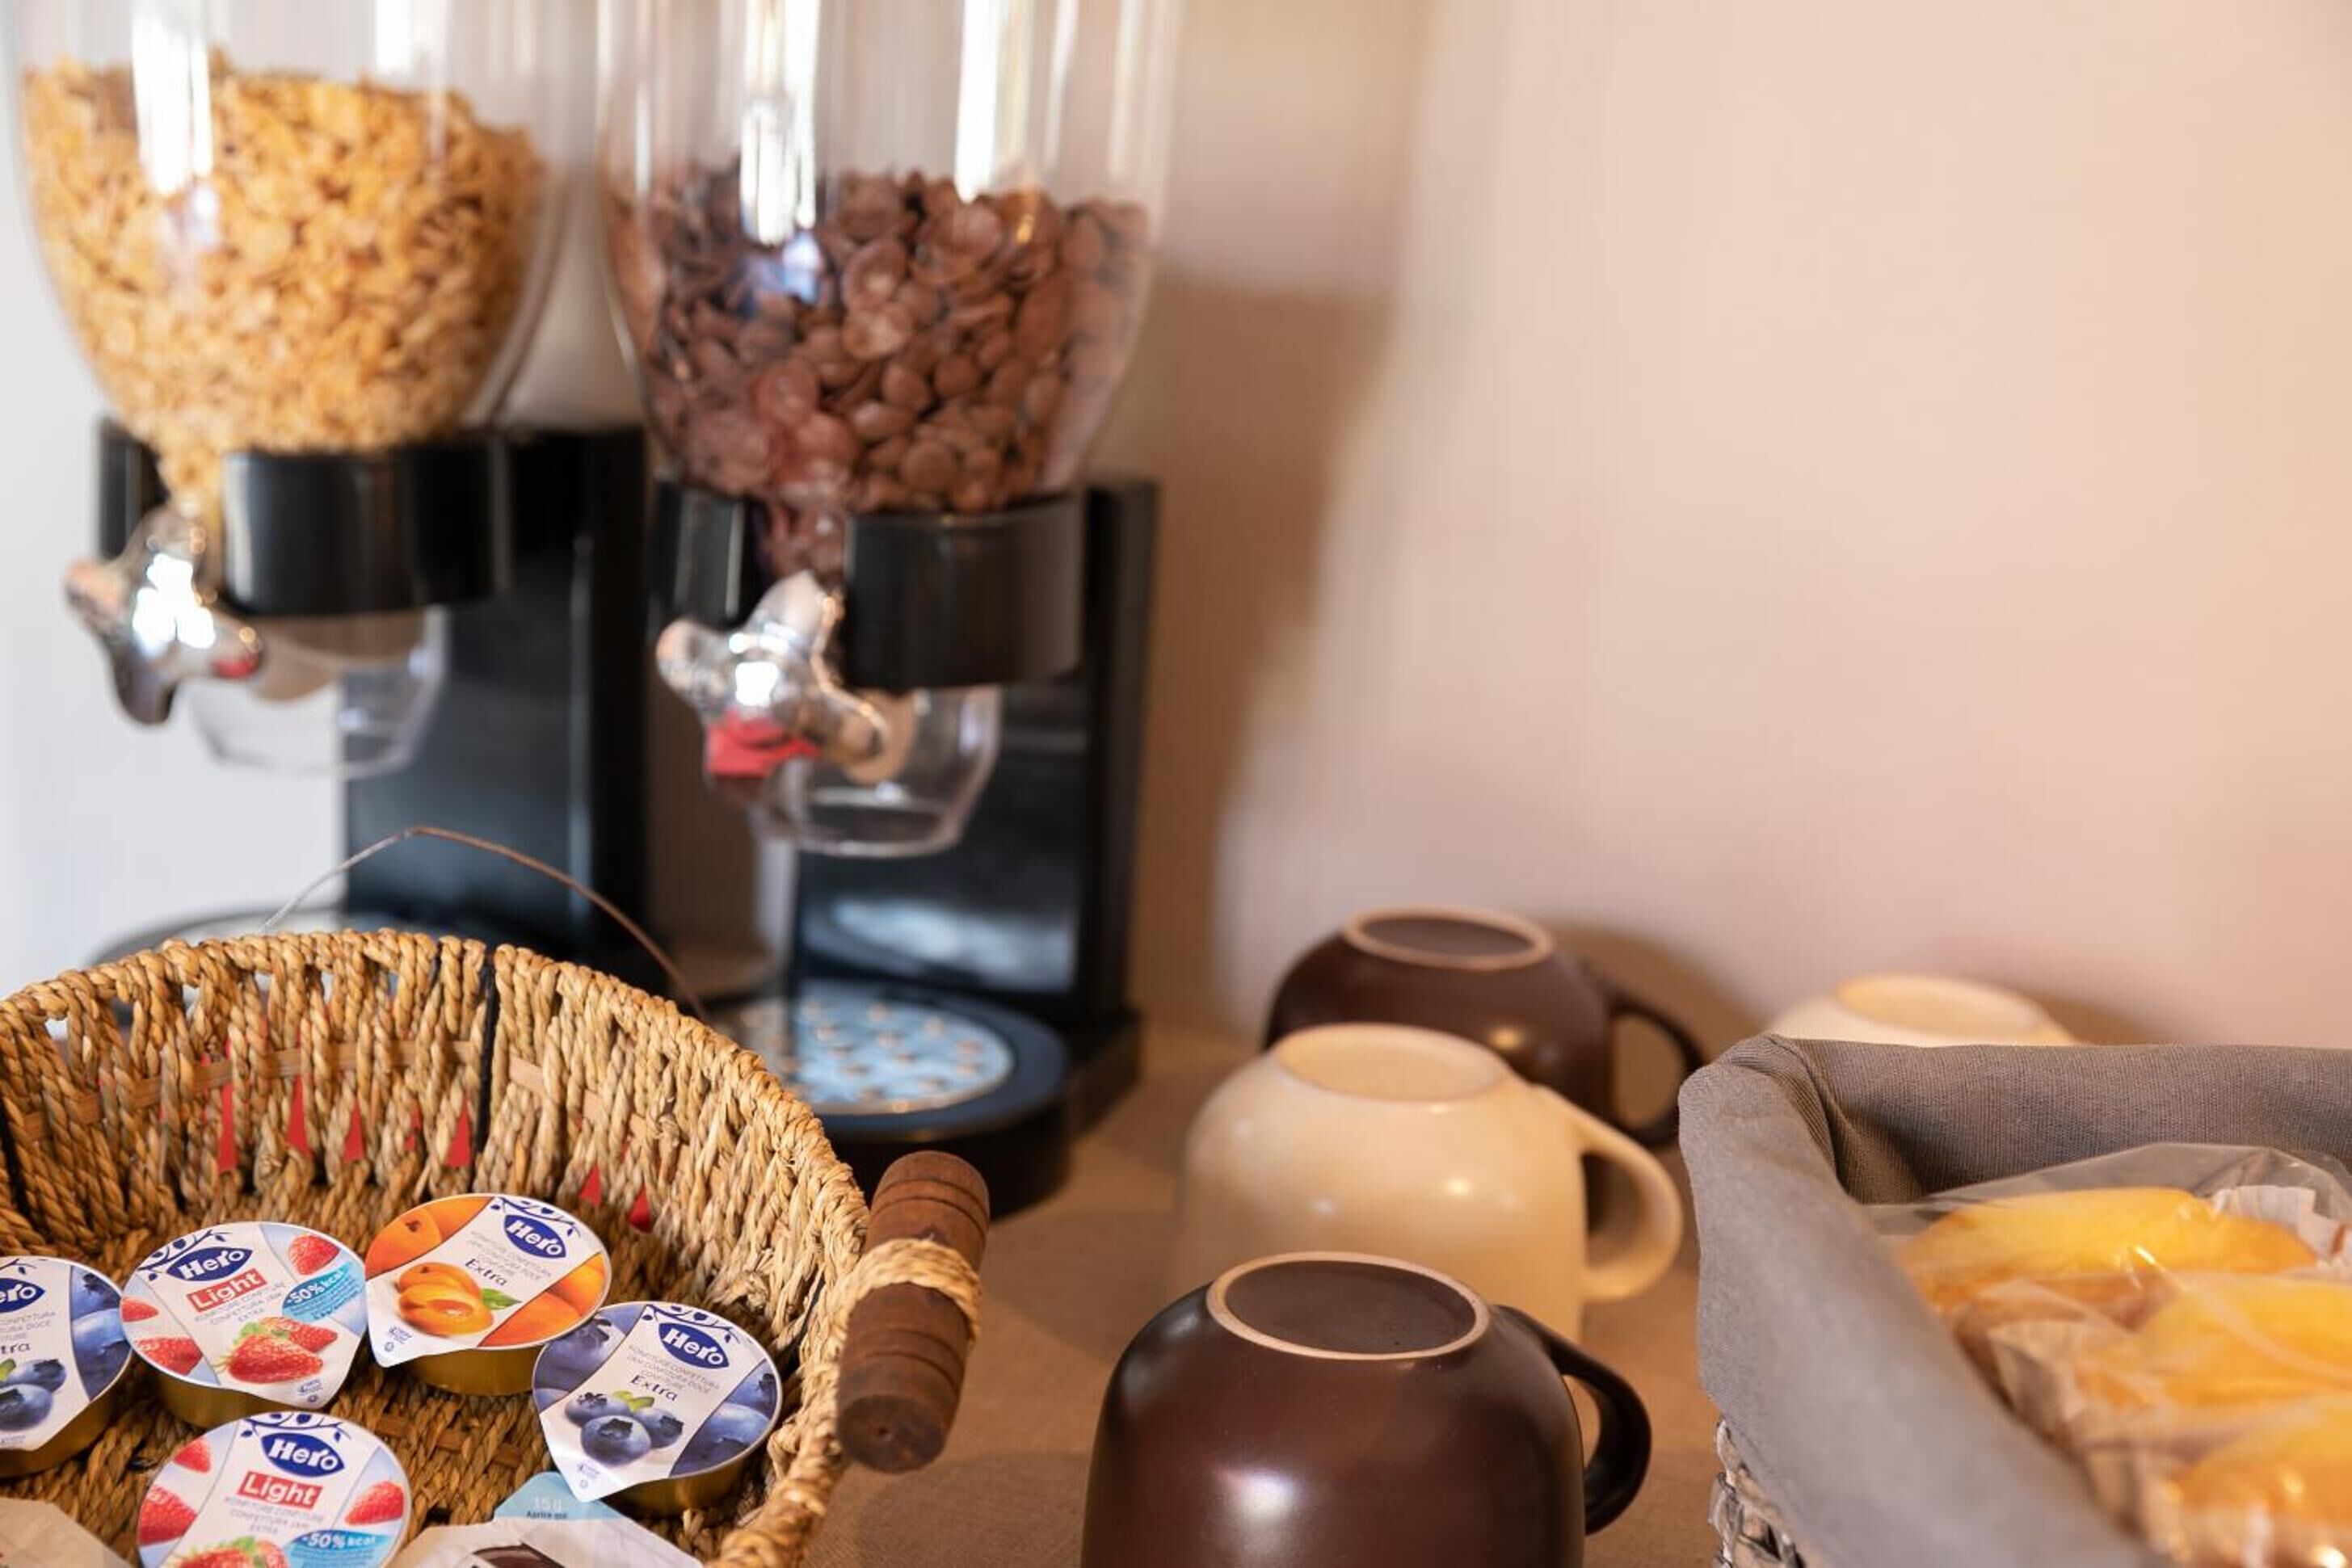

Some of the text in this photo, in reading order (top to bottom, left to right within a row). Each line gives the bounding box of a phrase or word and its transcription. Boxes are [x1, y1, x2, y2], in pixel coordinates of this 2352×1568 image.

[506, 1219, 562, 1255] Hero
[178, 1250, 244, 1280] Hero
[465, 1259, 507, 1285] Extra
[191, 1272, 261, 1308] Light
[0, 1343, 30, 1354] tra
[663, 1328, 723, 1365] Hero
[631, 1375, 677, 1402] Extra
[267, 1439, 338, 1470] Hero
[243, 1473, 317, 1504] Light
